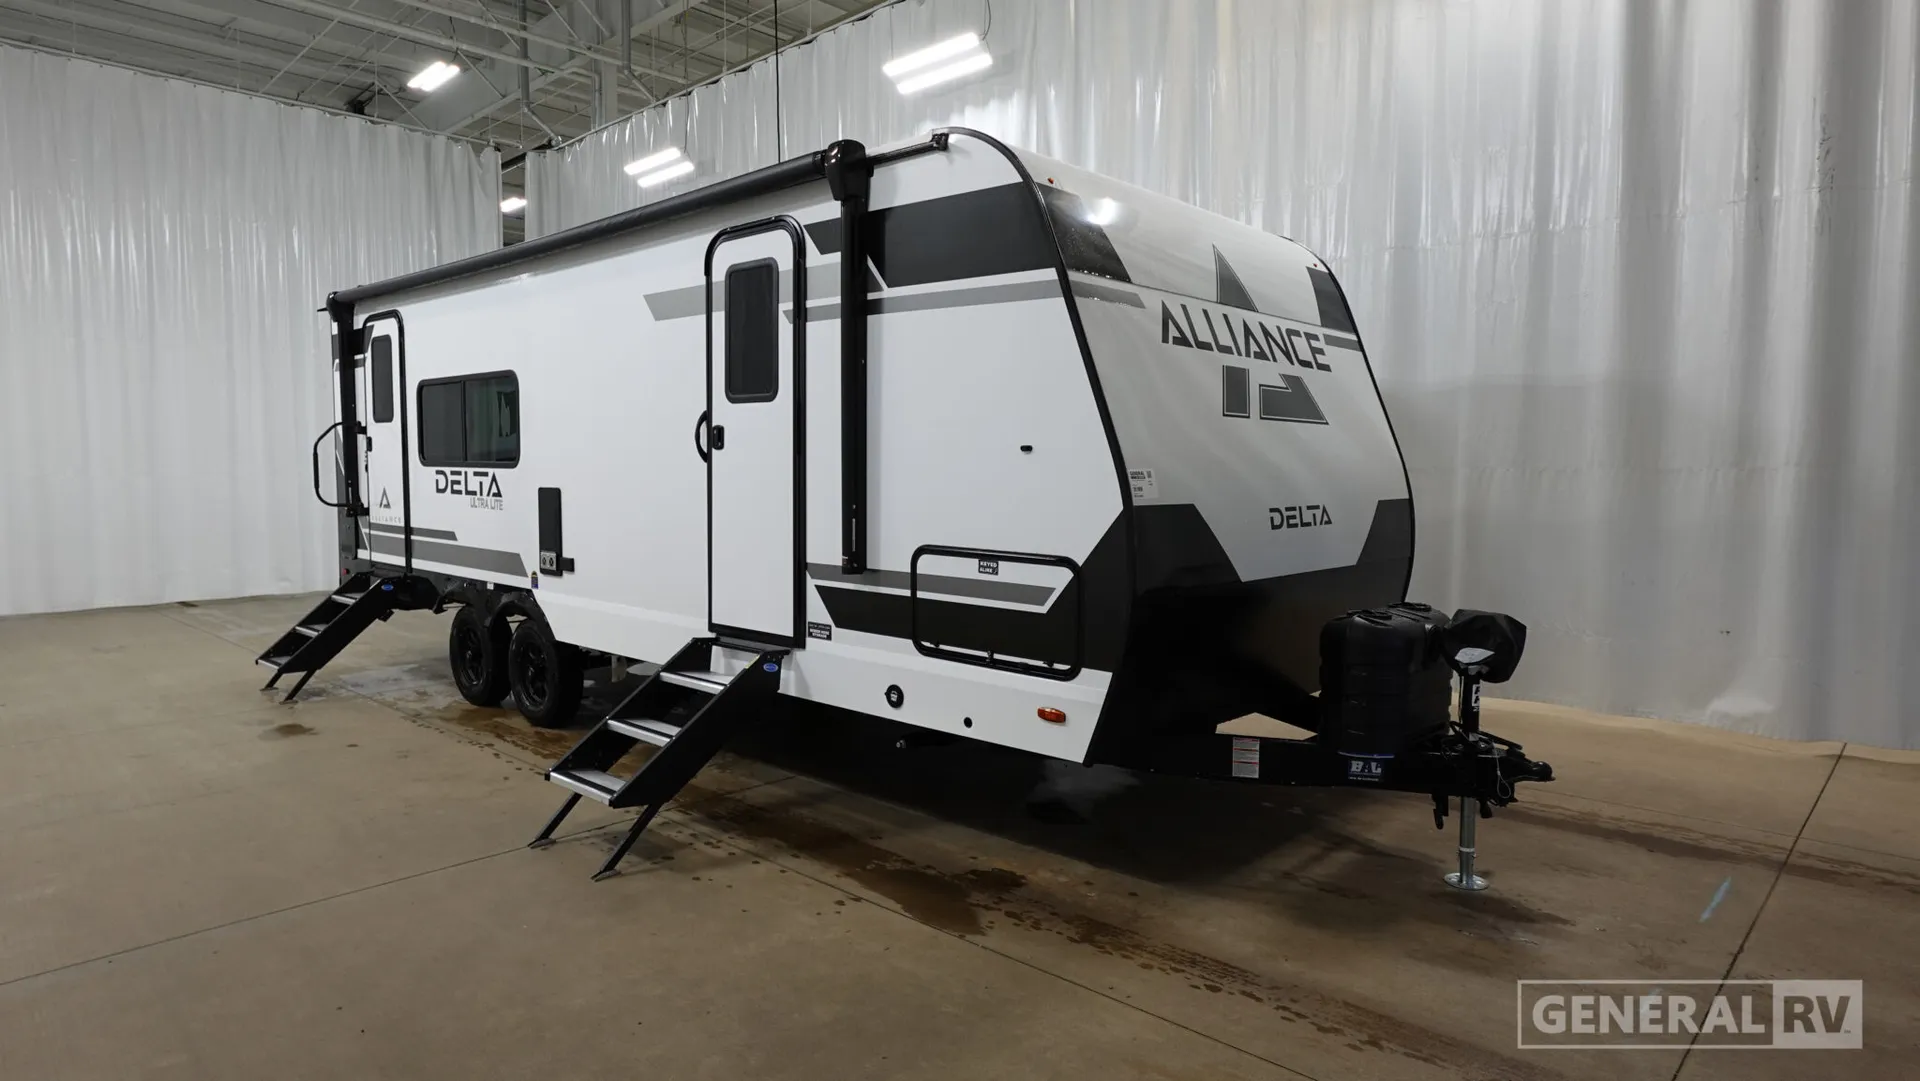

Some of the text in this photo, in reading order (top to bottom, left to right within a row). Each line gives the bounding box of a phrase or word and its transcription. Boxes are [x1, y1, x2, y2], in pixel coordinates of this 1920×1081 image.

[1161, 300, 1332, 372] ALLIANCE
[435, 470, 503, 498] DELTA
[470, 497, 503, 511] ULTRA LITE
[1269, 504, 1333, 530] DELTA
